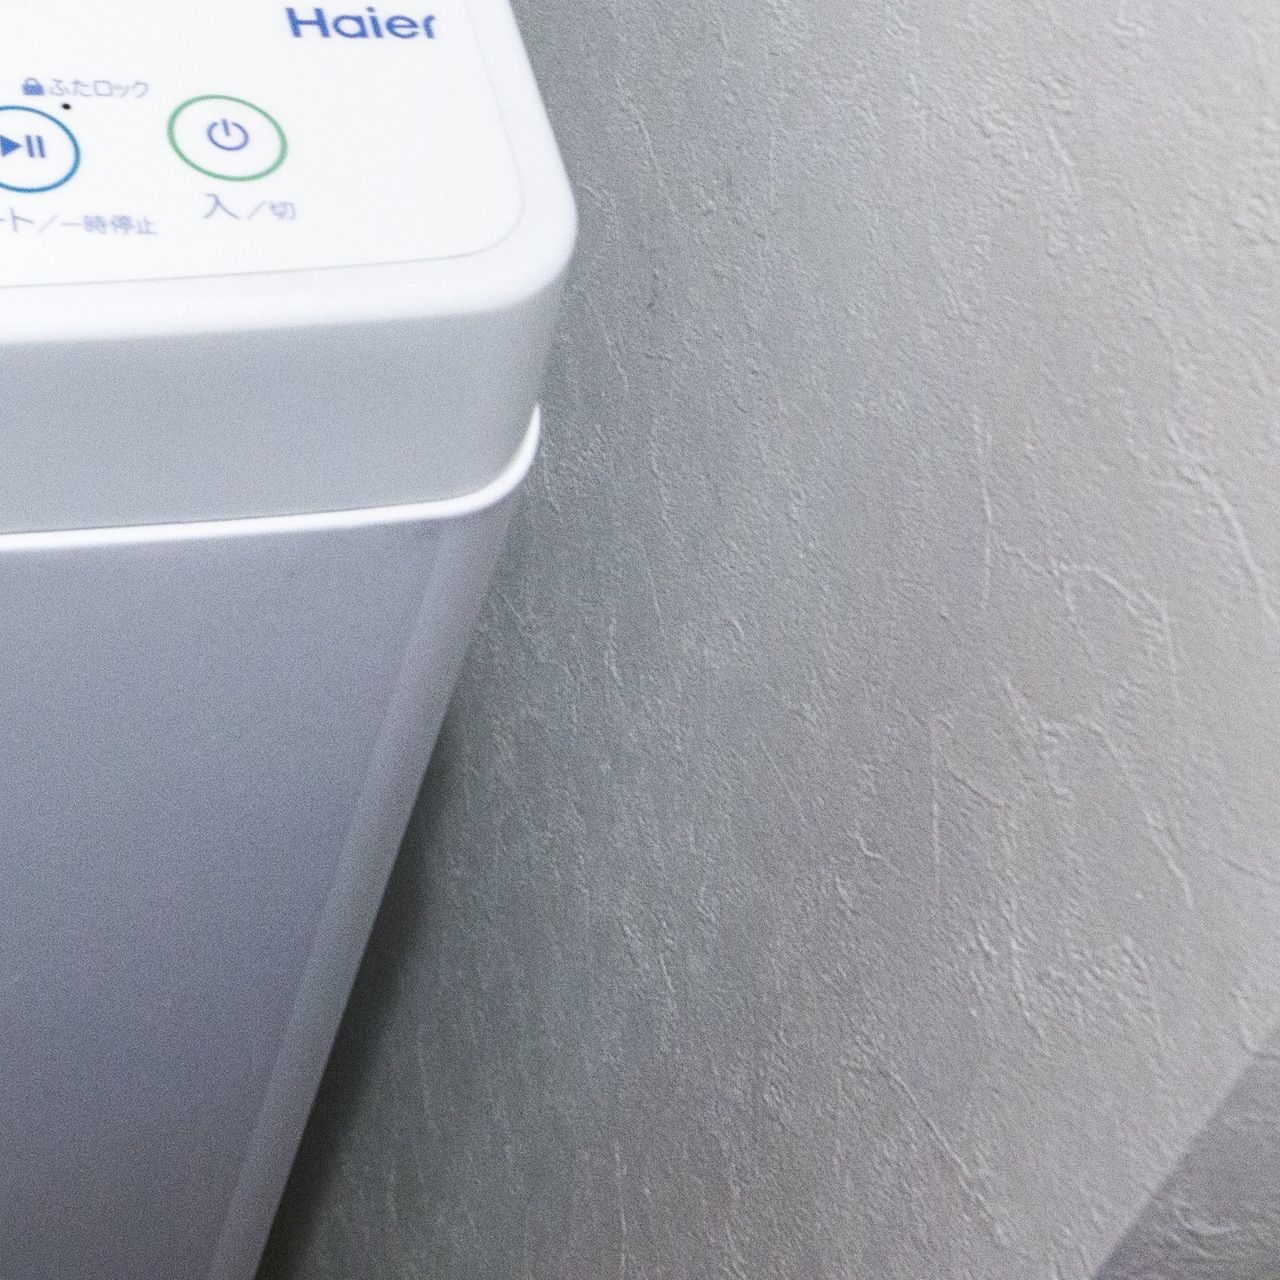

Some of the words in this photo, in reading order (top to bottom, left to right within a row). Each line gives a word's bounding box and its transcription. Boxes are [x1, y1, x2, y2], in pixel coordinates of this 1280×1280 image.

[285, 7, 438, 40] Haier
[48, 77, 152, 99] ふたロック
